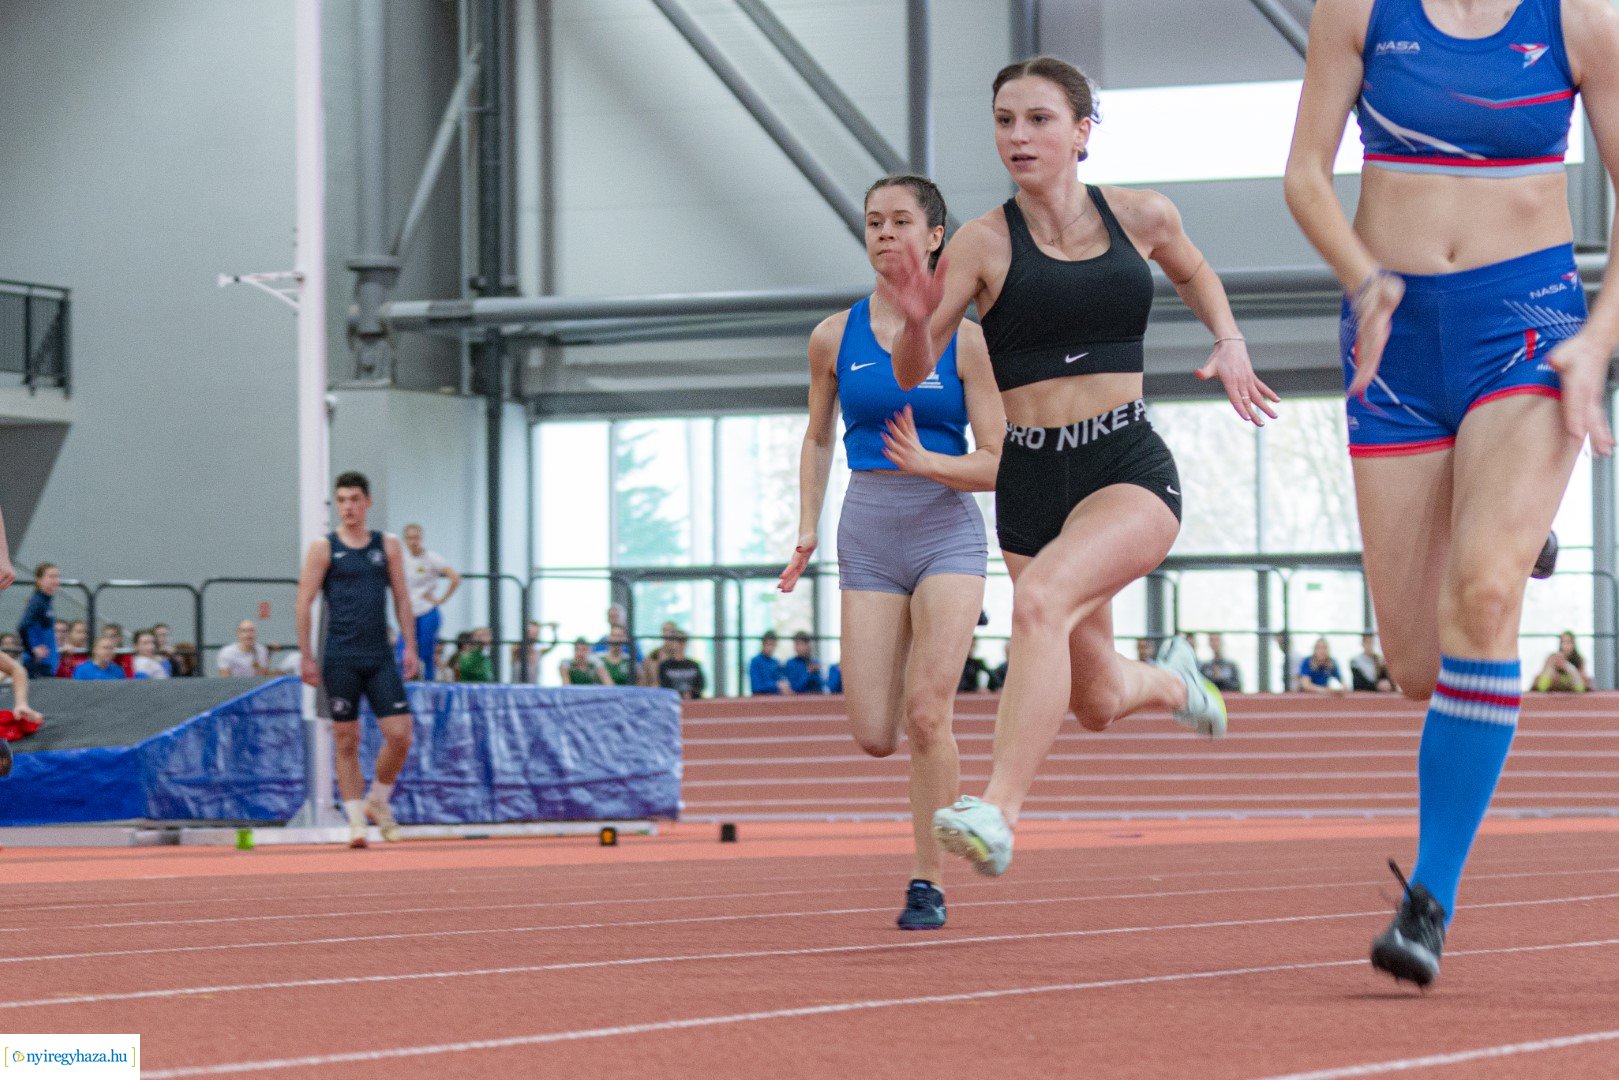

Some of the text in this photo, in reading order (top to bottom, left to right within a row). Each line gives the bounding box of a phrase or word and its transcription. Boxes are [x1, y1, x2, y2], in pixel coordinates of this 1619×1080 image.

[1376, 41, 1420, 52] NASA
[1530, 282, 1567, 299] NASA
[1056, 404, 1129, 451] NIKE
